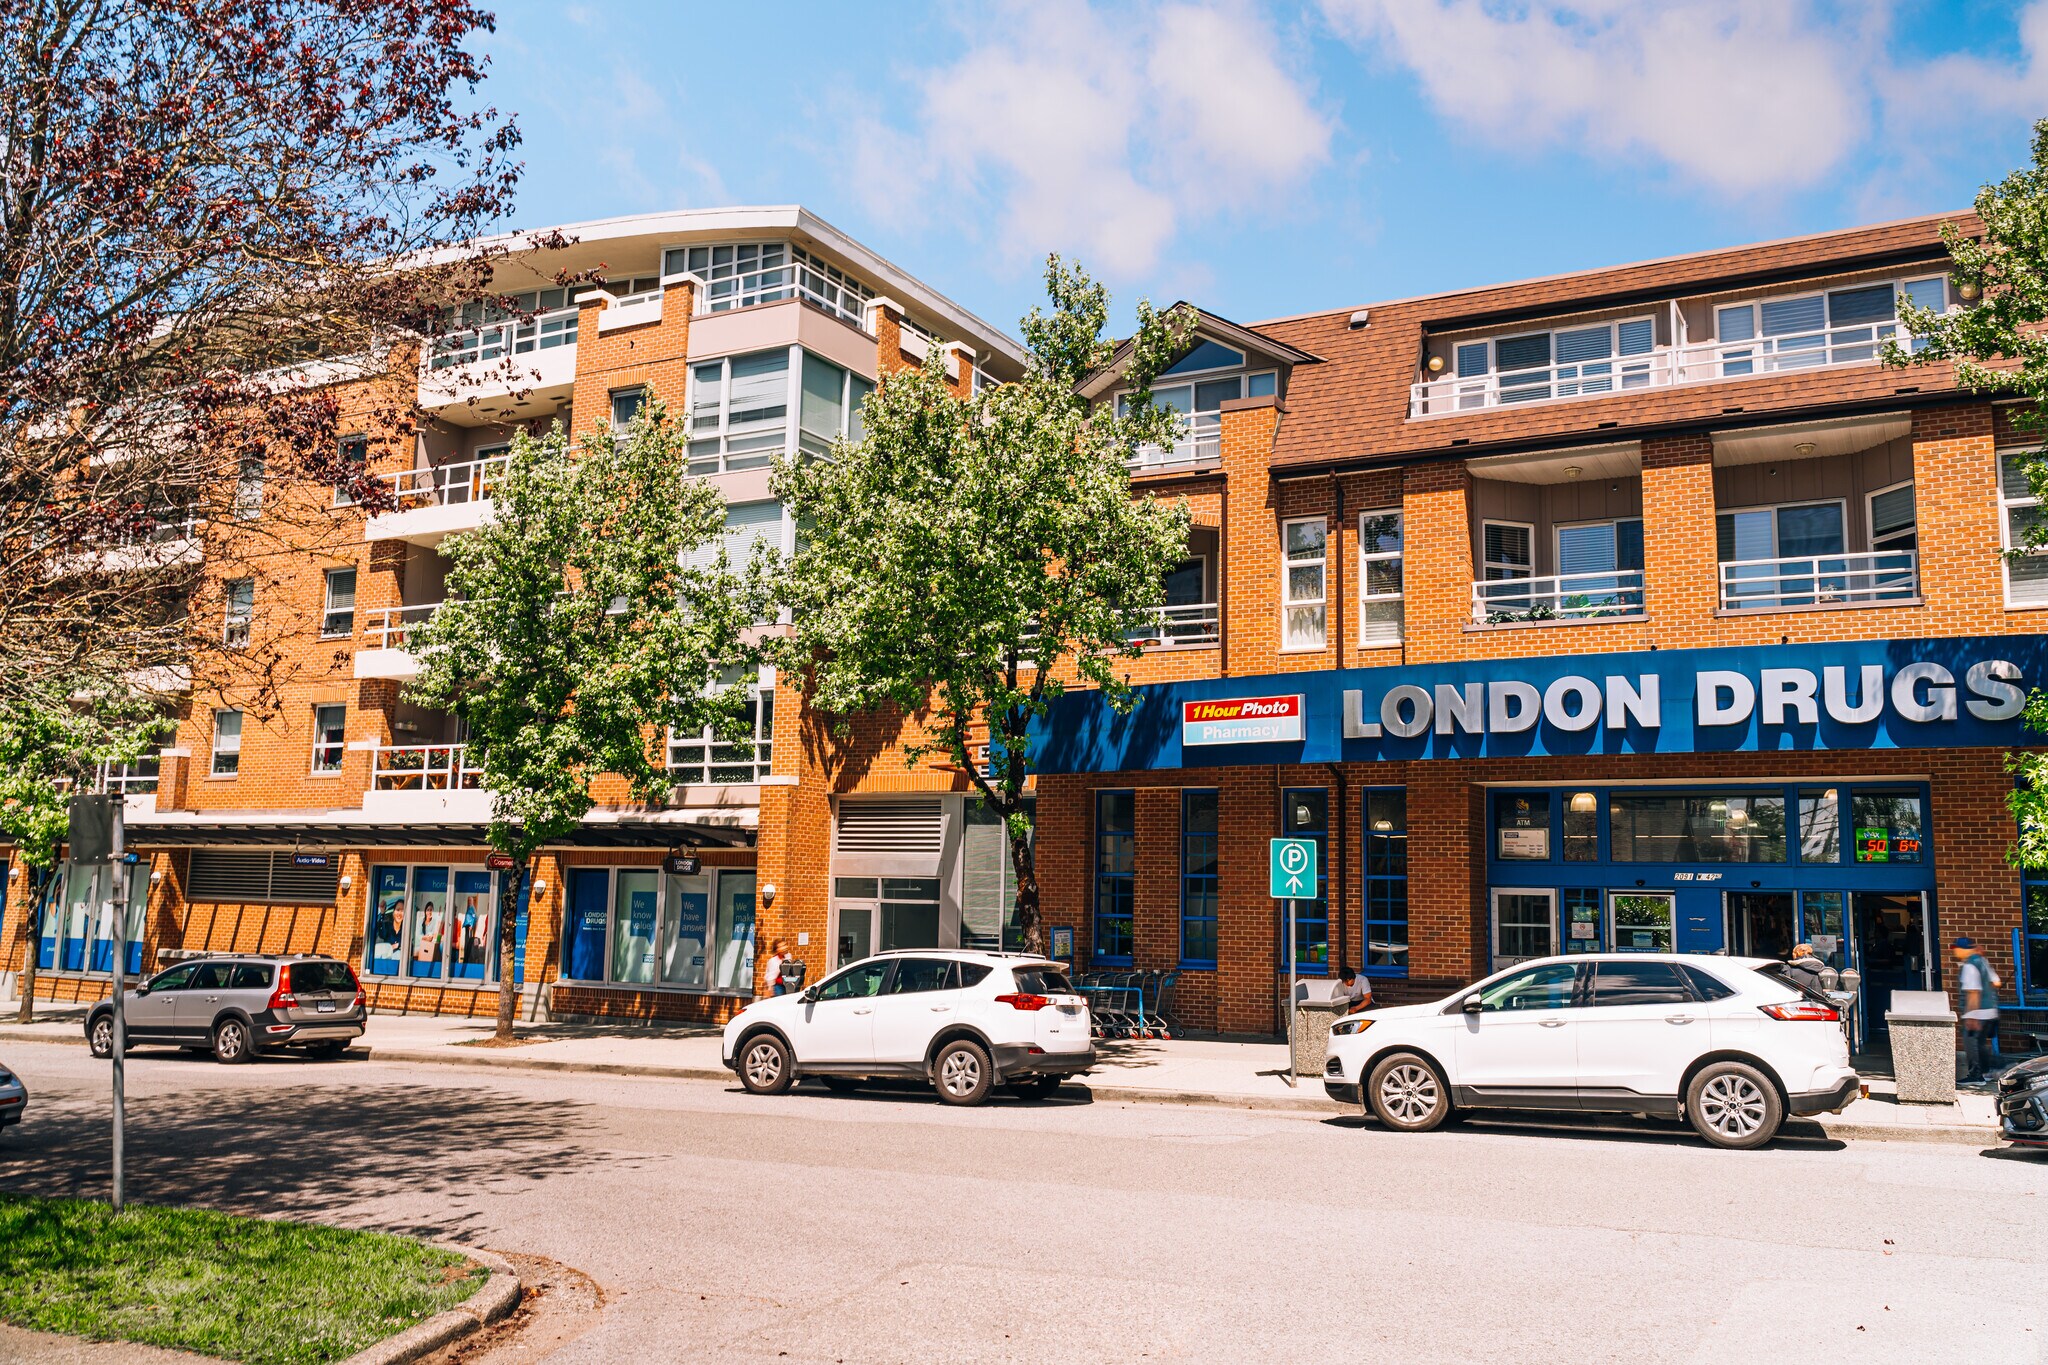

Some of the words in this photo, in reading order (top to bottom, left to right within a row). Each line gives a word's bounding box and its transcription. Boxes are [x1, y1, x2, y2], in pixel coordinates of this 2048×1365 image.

[1342, 674, 1662, 739] LONDON
[1696, 659, 2028, 727] DRUGS
[1193, 705, 1201, 719] 1
[1201, 704, 1241, 719] Hour
[1241, 701, 1290, 716] Photo
[1203, 724, 1280, 740] Pharmacy
[1868, 840, 1887, 852] 50
[1899, 840, 1919, 852] 64
[1288, 849, 1302, 868] P
[432, 880, 447, 888] hom
[474, 880, 490, 890] trave
[633, 900, 645, 909] We
[683, 901, 695, 911] We
[735, 902, 748, 911] We
[633, 911, 653, 920] know
[683, 912, 700, 921] have
[735, 912, 755, 922] make
[682, 924, 706, 932] answer
[741, 925, 755, 933] eas
